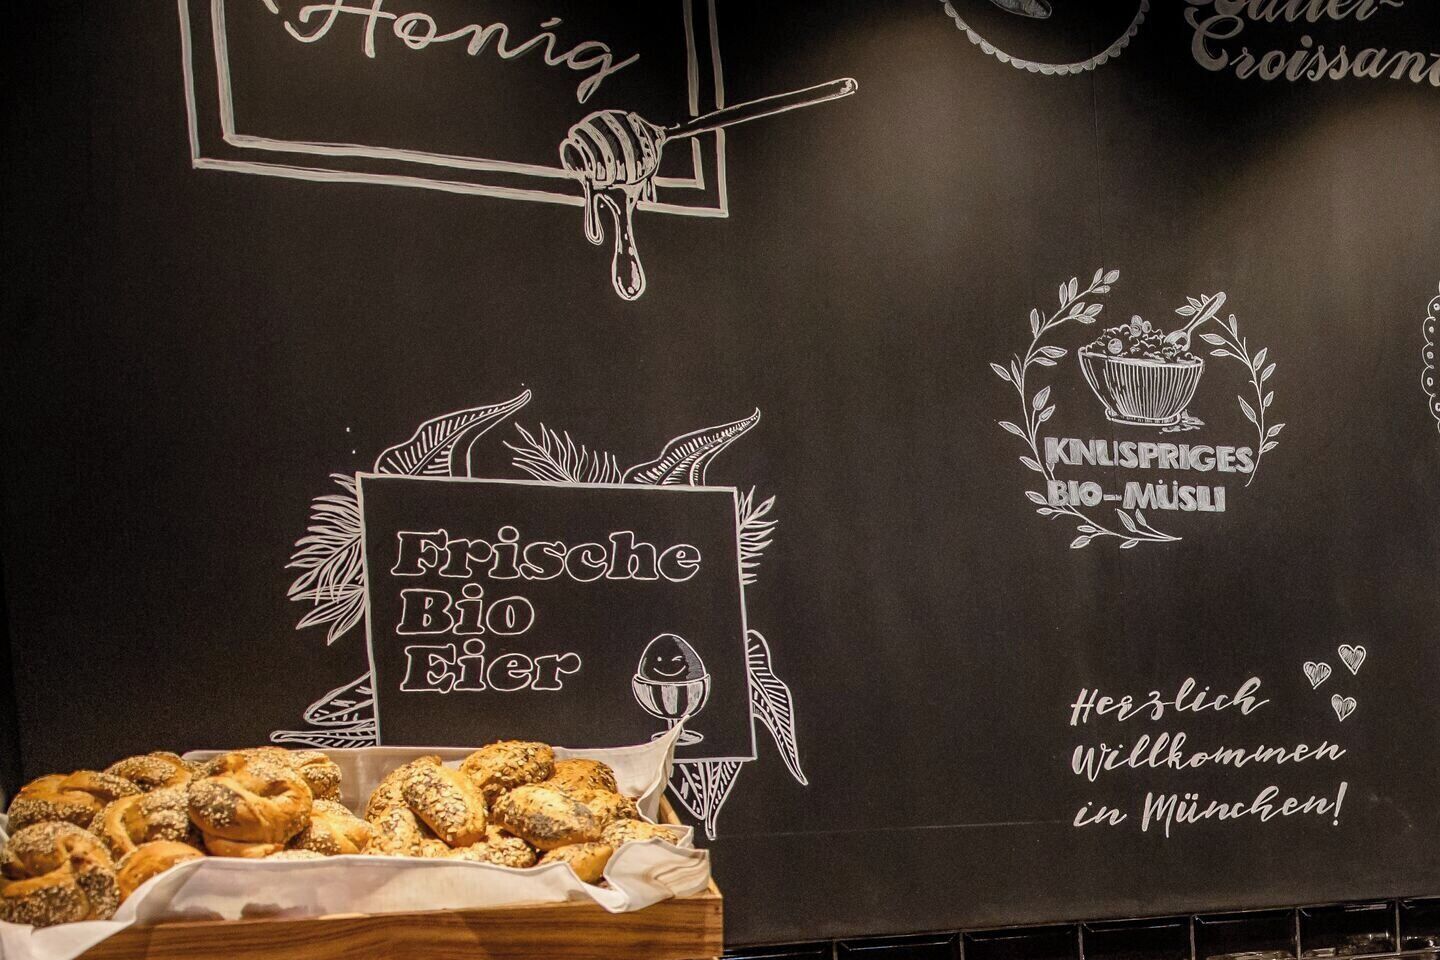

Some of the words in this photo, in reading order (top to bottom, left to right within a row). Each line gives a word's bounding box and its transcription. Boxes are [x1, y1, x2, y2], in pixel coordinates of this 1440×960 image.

[1044, 436, 1255, 474] KNUSPRIGES
[1047, 478, 1226, 512] BIO-MÜSLI
[390, 525, 702, 583] Frische
[396, 583, 535, 636] Bio
[399, 638, 582, 693] Eier
[1070, 676, 1270, 727] Herzlich
[1071, 731, 1347, 783] Willkommen
[1073, 801, 1128, 827] in
[1141, 781, 1349, 838] München!
